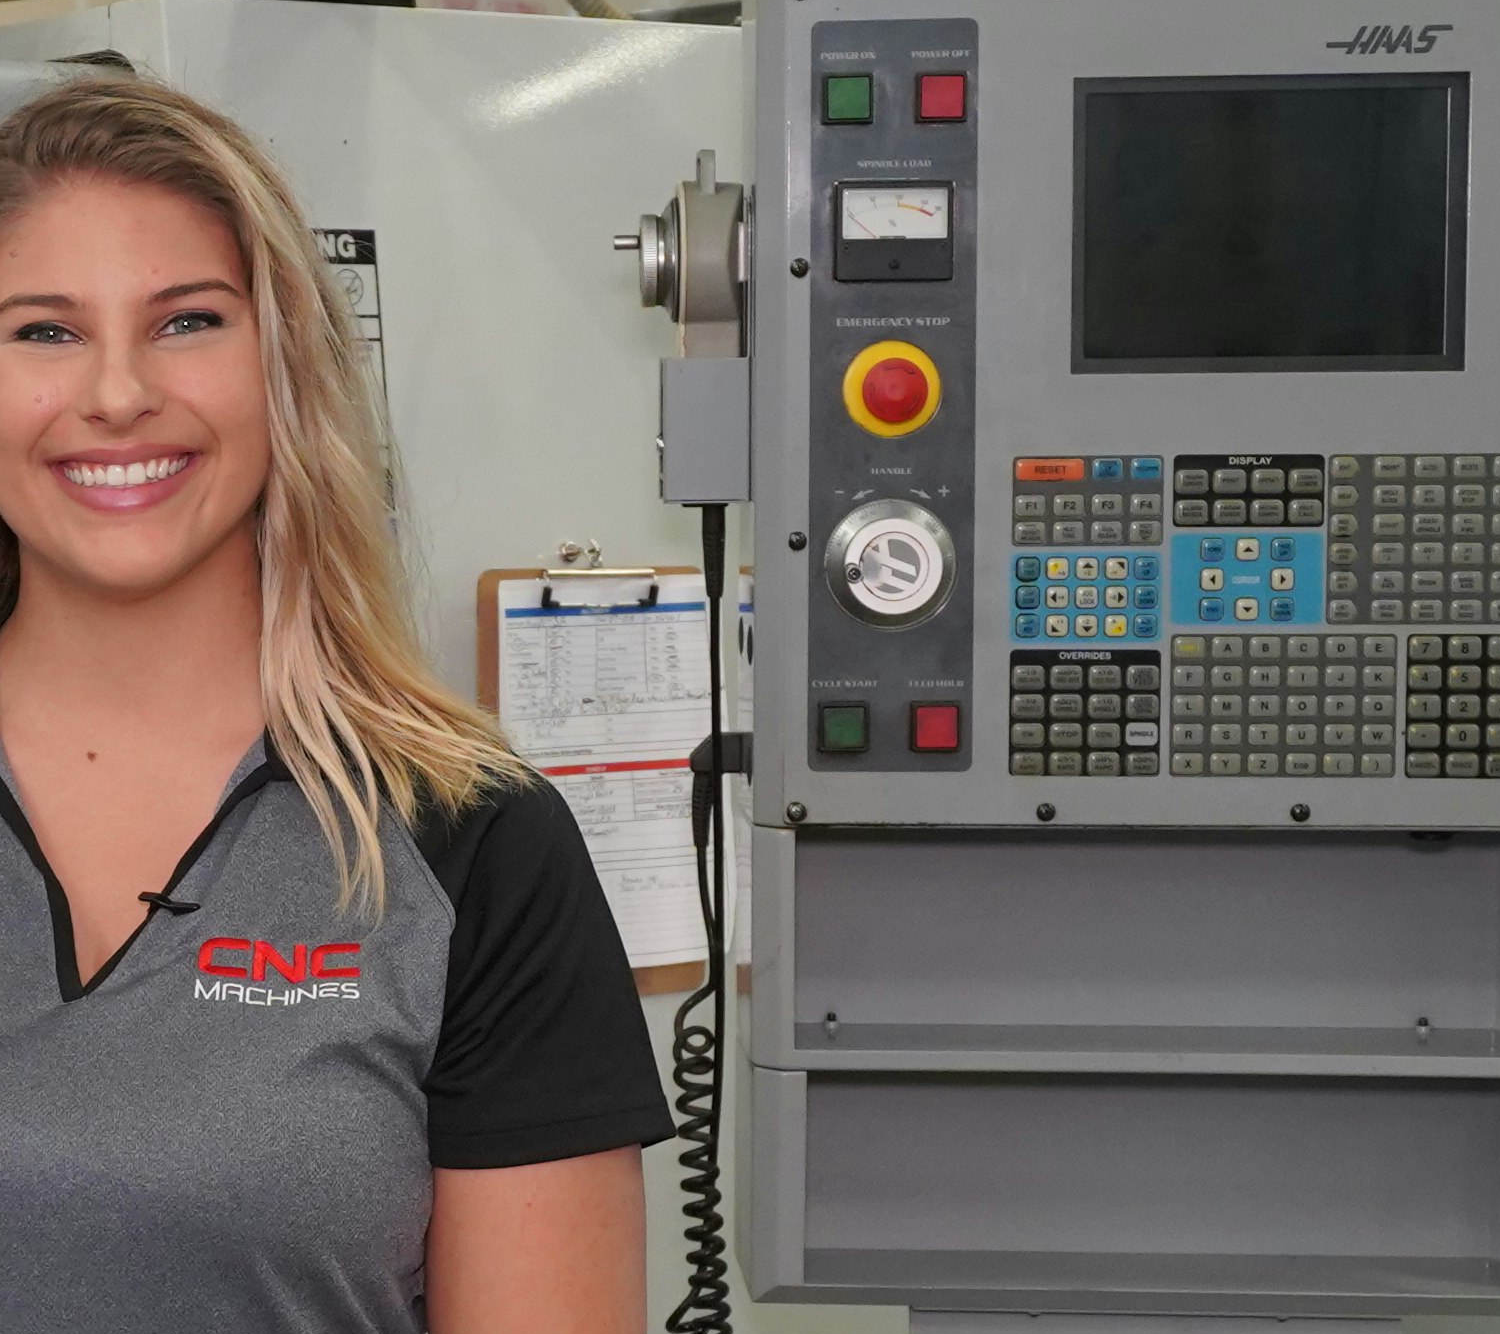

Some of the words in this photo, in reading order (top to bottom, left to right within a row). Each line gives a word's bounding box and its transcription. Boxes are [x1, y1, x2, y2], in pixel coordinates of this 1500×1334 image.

[1326, 24, 1453, 54] HAAS
[911, 50, 950, 58] POWER
[836, 318, 913, 327] EMERGENCY
[916, 317, 950, 325] STOP
[1229, 457, 1273, 465] DISPLAY
[871, 467, 912, 475] HANDLE
[1035, 466, 1066, 474] RESET
[1026, 502, 1037, 510] F1
[1064, 501, 1076, 510] F2
[1102, 501, 1114, 509] F3
[1140, 501, 1152, 509] F4
[1224, 643, 1231, 652] A
[1262, 643, 1269, 652] B
[1300, 643, 1308, 652] C
[1337, 643, 1345, 652] D
[1375, 643, 1383, 652] E
[1422, 643, 1430, 653] 7
[1461, 643, 1469, 654] 8
[1059, 651, 1112, 660] OVERRIDES
[1186, 672, 1192, 681] F
[1224, 672, 1231, 681] G
[1261, 672, 1269, 681] H
[1337, 672, 1344, 681] J
[1374, 672, 1382, 681] K
[1422, 673, 1428, 682] 4
[1461, 673, 1468, 682] 5
[1186, 702, 1192, 710] L
[1222, 702, 1231, 710] M
[1260, 701, 1269, 710] N
[1298, 701, 1306, 710] O
[1336, 702, 1344, 710] P
[1374, 702, 1383, 711] Q
[1424, 702, 1428, 711] 1
[1459, 702, 1467, 712] 2
[1185, 731, 1192, 739] R
[1222, 731, 1230, 740] S
[1260, 731, 1268, 739] T
[1298, 731, 1306, 740] U
[1336, 731, 1343, 740] V
[1372, 731, 1383, 740] W
[1184, 759, 1192, 768] X
[1222, 759, 1230, 768] Y
[1260, 759, 1267, 768] Z
[198, 937, 361, 983] CNC
[194, 979, 360, 1006] MACHINES
